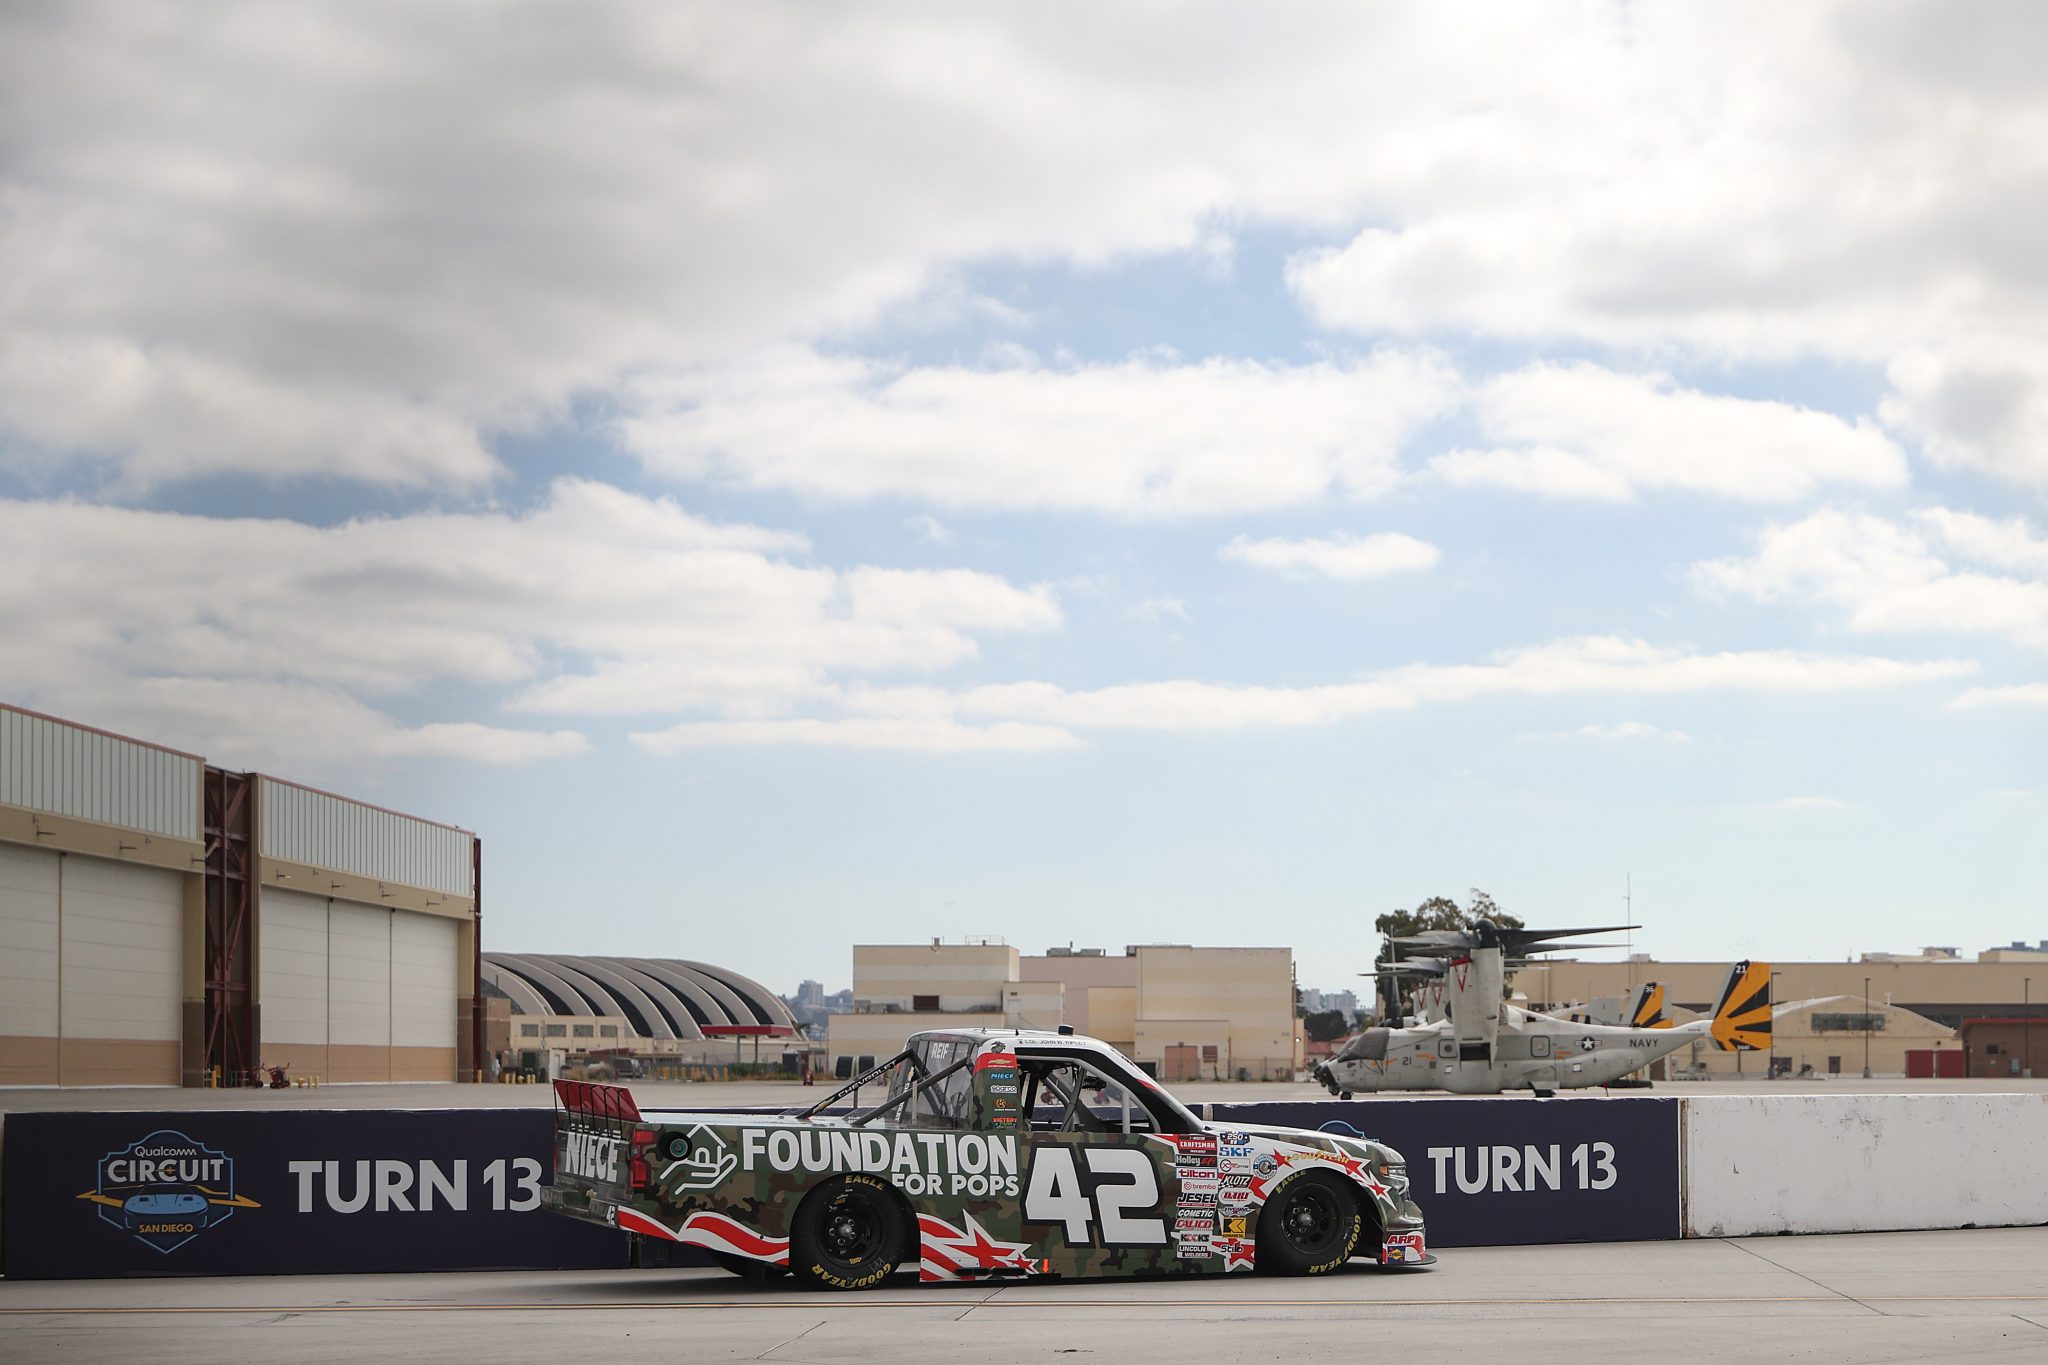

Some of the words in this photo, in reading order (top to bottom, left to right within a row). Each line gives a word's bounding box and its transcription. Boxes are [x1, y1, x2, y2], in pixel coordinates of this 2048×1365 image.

[1736, 965, 1746, 973] 21
[1630, 1038, 1659, 1047] NAVY
[931, 1043, 949, 1059] REIF
[1402, 1056, 1412, 1066] 21
[838, 1059, 897, 1098] CHEVROLET
[1227, 1133, 1244, 1141] 250
[134, 1146, 197, 1157] Qualcomm
[565, 1131, 621, 1182] NIECE
[742, 1128, 1018, 1175] FOUNDATION
[1219, 1146, 1254, 1157] SKF
[1284, 1150, 1350, 1164] GOODYEAR
[1176, 1155, 1201, 1167] Holley
[107, 1159, 224, 1182] CIRCUIT
[1179, 1169, 1216, 1178] tilton
[1427, 1144, 1561, 1194] TURN
[1571, 1141, 1618, 1190] 13
[288, 1159, 468, 1213] TURN
[483, 1157, 543, 1212] 13
[845, 1174, 886, 1191] EAGLE
[892, 1173, 944, 1195] FOR
[952, 1174, 1020, 1197] POPS
[1223, 1176, 1251, 1186] KLOTZ
[1276, 1169, 1308, 1195] EAGLE
[1025, 1147, 1167, 1244] 42
[1177, 1193, 1217, 1203] JESEL
[1178, 1208, 1214, 1218] COMETIC
[139, 1224, 160, 1233] SAN
[161, 1223, 194, 1233] DIEGO
[1176, 1219, 1214, 1229] CALICO
[1309, 1214, 1362, 1274] GOODYEAR
[1388, 1235, 1416, 1244] ARP
[1221, 1243, 1244, 1252] Stilo
[811, 1263, 892, 1289] GOODYEAR
